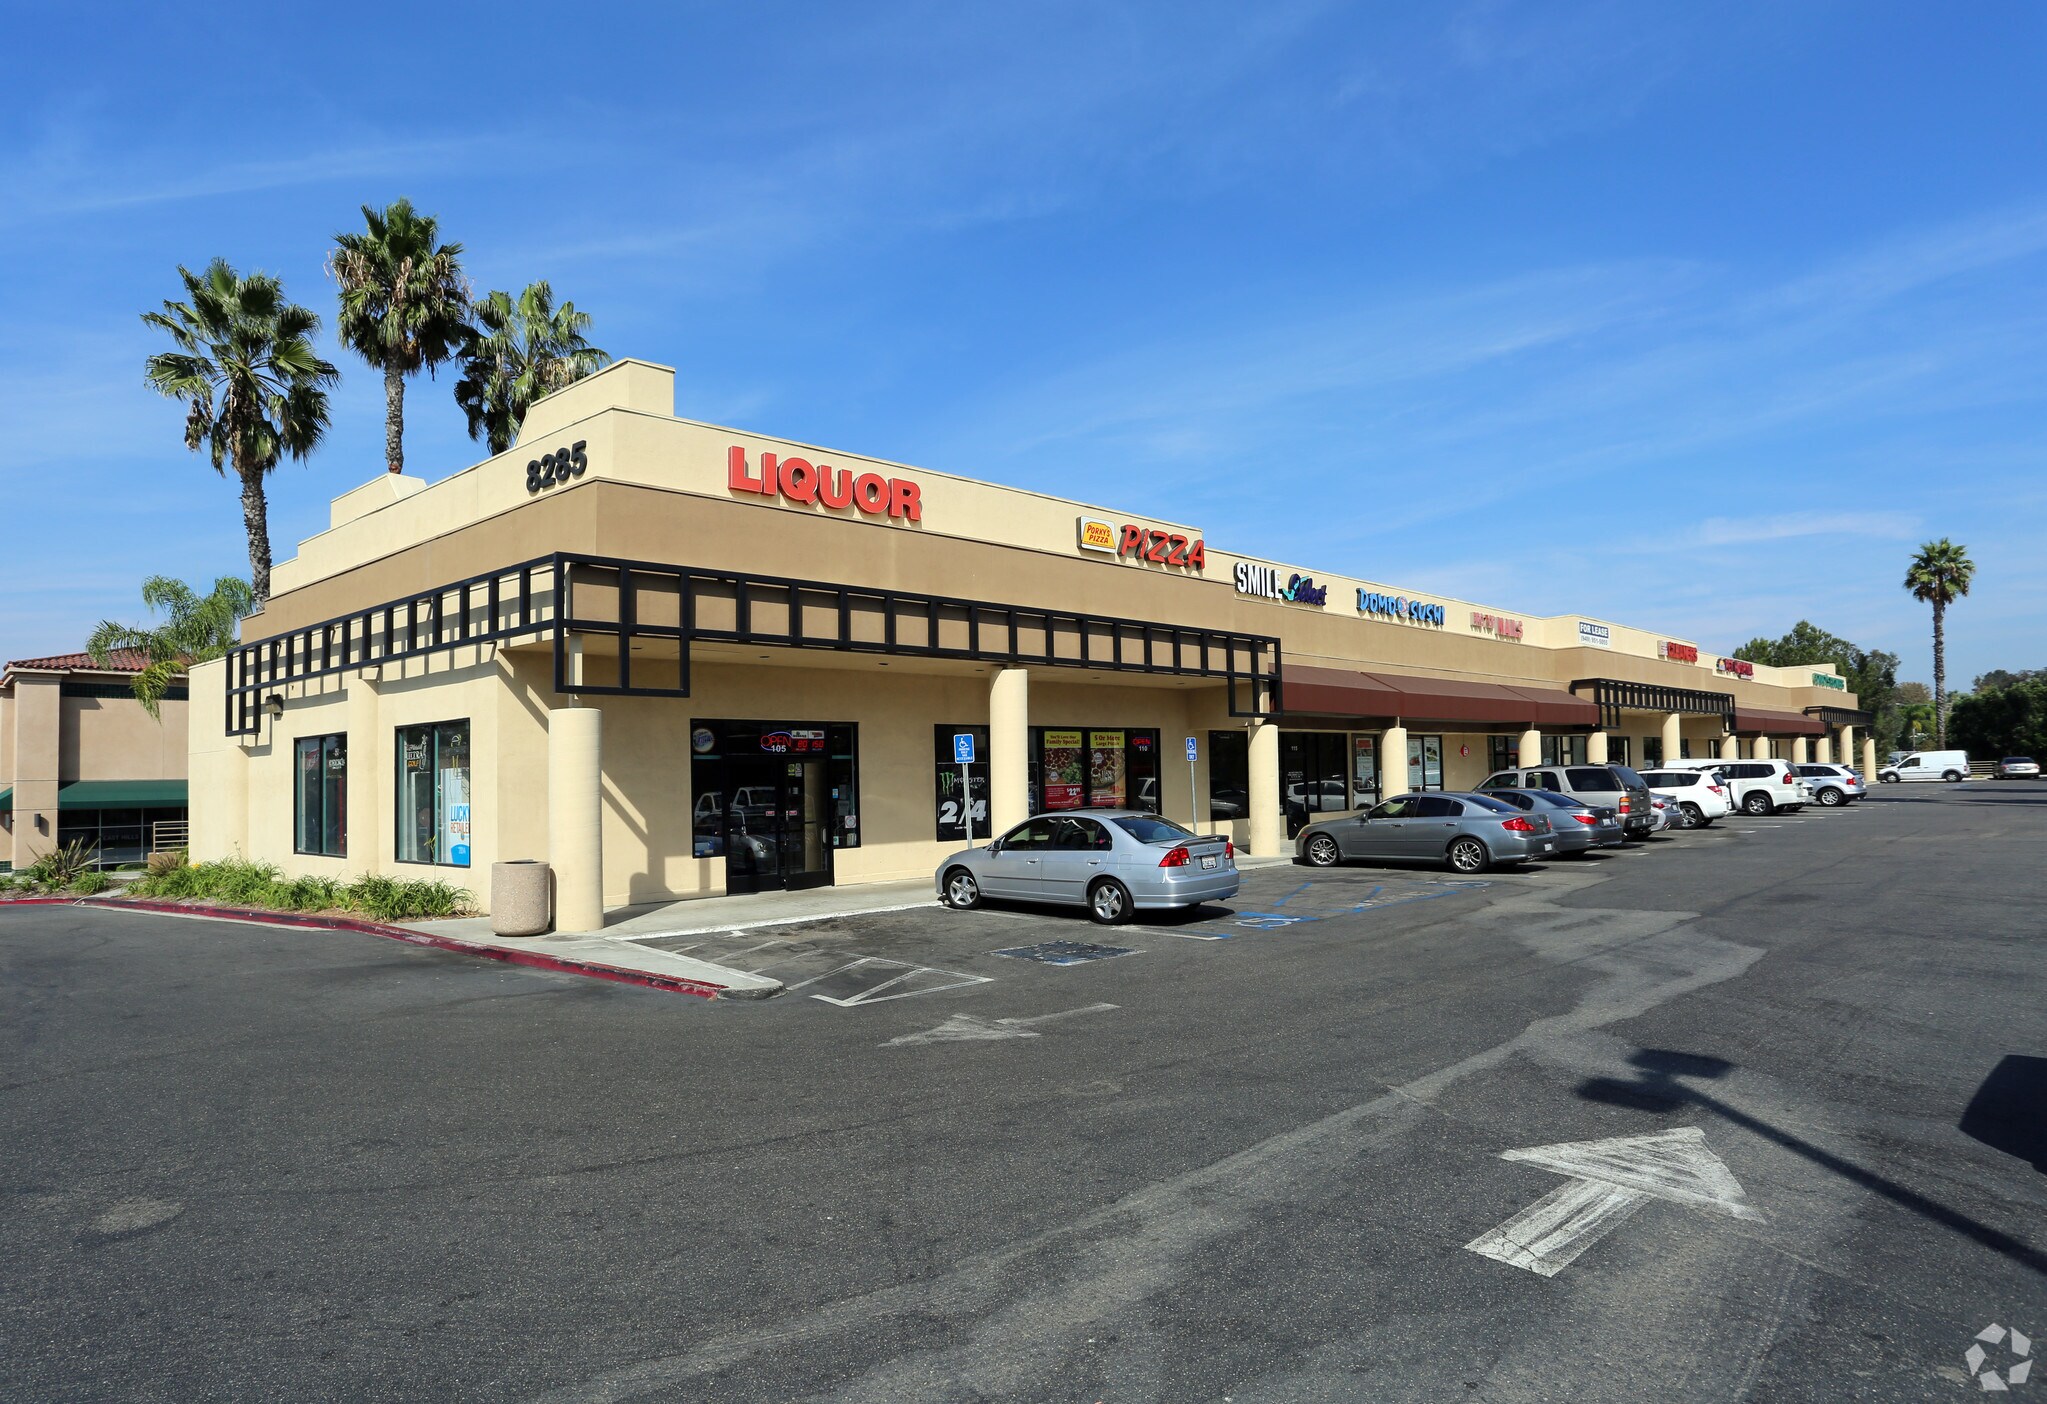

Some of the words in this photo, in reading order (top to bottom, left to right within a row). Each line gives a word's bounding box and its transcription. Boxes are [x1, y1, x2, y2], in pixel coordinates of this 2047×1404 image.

[526, 440, 587, 492] 8285
[728, 446, 921, 521] LIQUOR
[1088, 535, 1109, 544] PIZZA
[1117, 524, 1205, 569] PIZZA
[1234, 562, 1282, 599] SMILE
[1356, 588, 1396, 615] DOMO
[1409, 600, 1445, 625] SUSHI
[1580, 623, 1591, 634] FOR
[1591, 626, 1608, 637] LEASE
[760, 735, 792, 747] OPEN
[771, 744, 786, 752] 105
